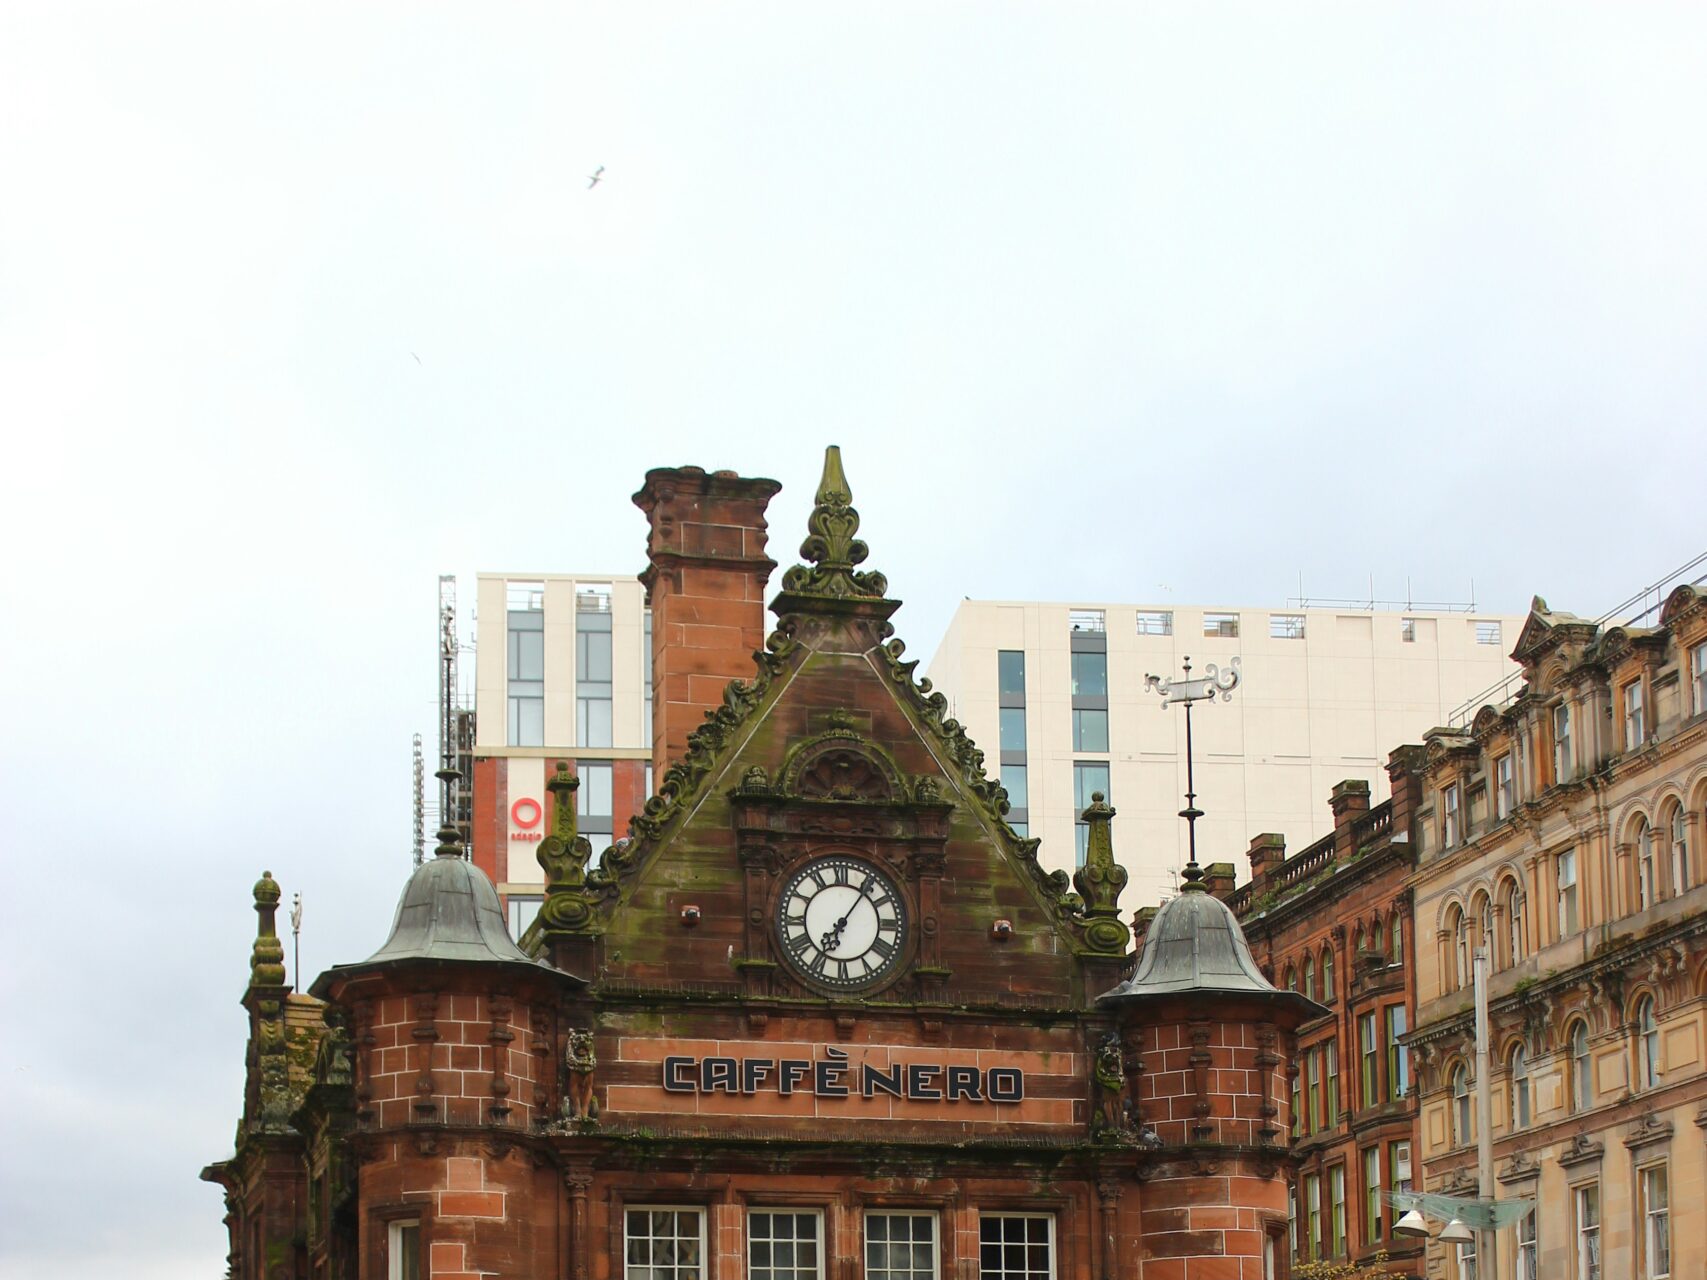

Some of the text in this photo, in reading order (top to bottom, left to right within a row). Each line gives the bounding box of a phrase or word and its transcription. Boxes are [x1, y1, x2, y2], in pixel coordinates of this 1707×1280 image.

[511, 831, 542, 844] adagio
[662, 1045, 1025, 1103] CAFFÈ NERO
